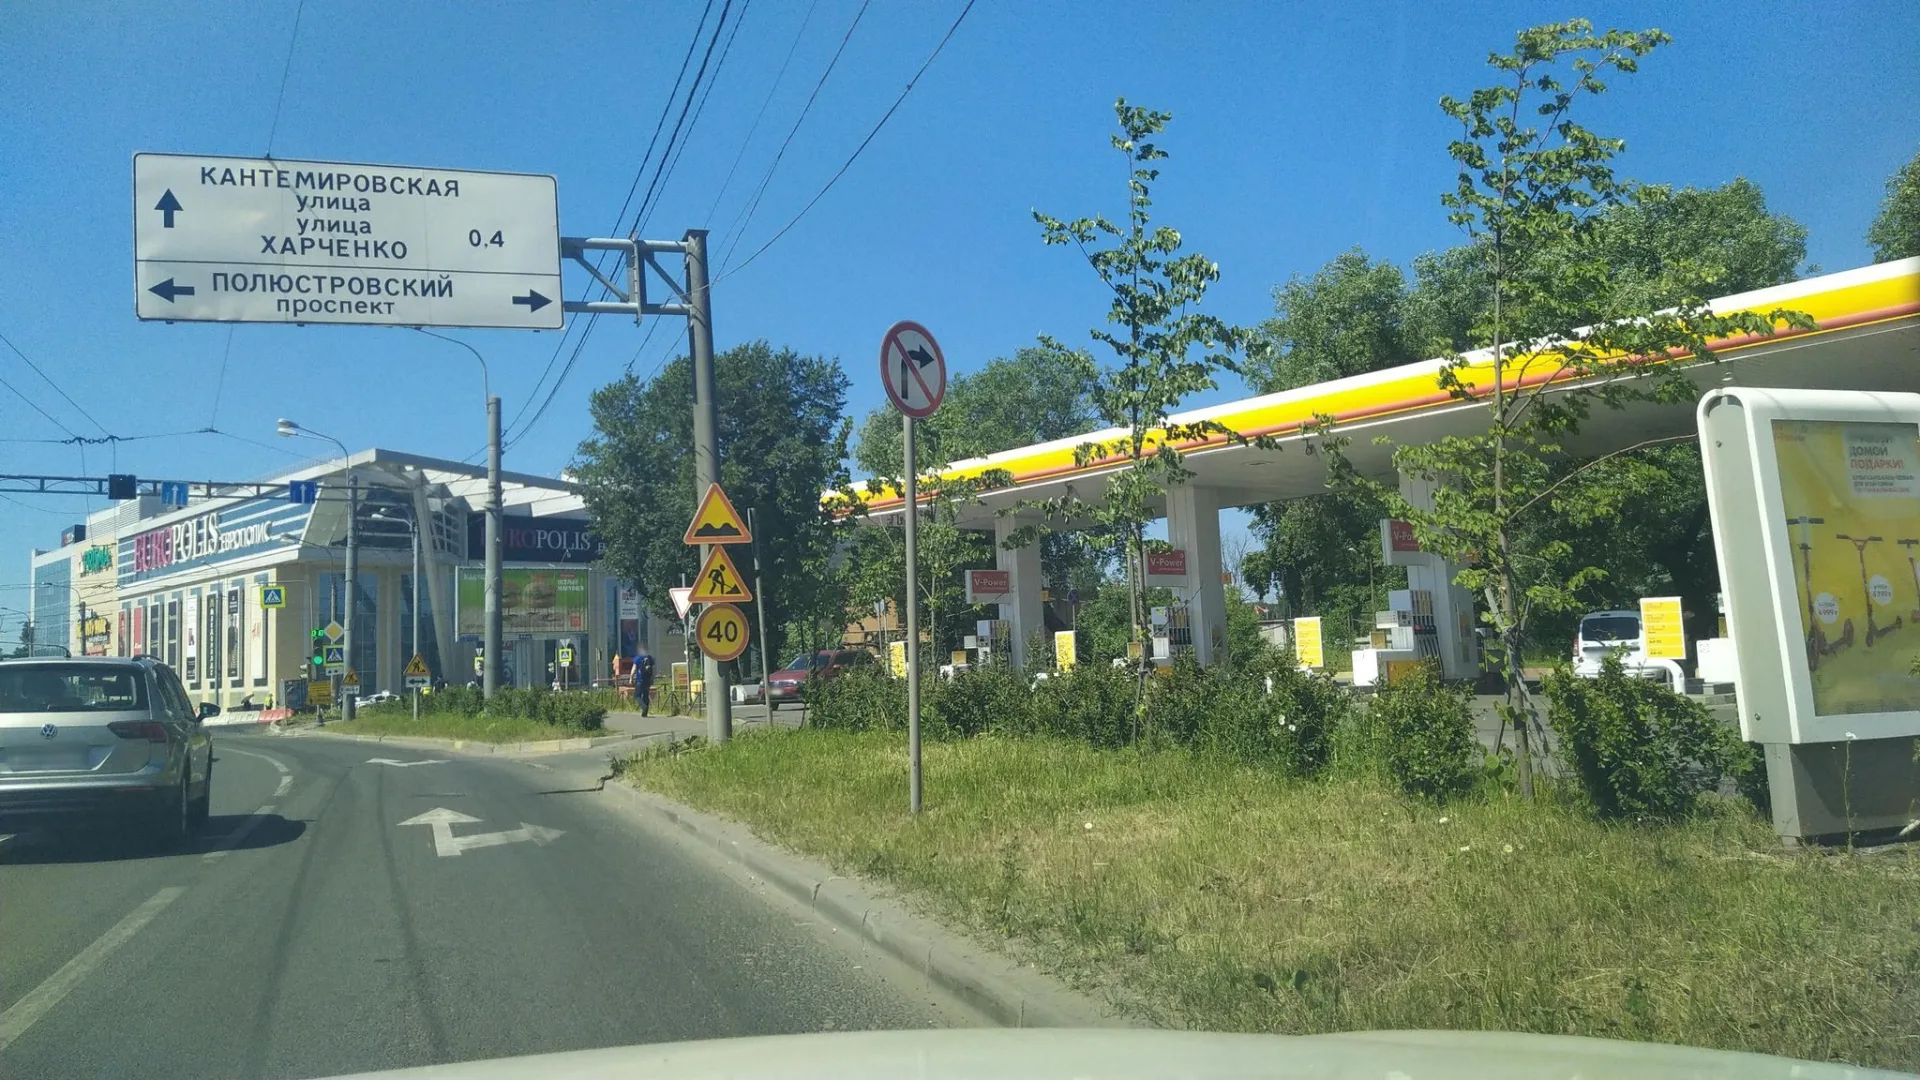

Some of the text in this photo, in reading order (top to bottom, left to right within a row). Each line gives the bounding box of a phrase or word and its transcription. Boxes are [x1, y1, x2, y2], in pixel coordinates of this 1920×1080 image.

[201, 166, 459, 198] КАНТЕМИРОВСКАЯ
[296, 194, 370, 213] улица
[296, 218, 371, 237] улица
[260, 235, 408, 260] ХАРЧЕНКО
[212, 272, 453, 298] ПОЛЮСТРОВСКИЙ
[277, 298, 395, 318] проспект
[133, 511, 220, 573] EUROPOLIS
[1150, 557, 1183, 567] V-Power
[973, 578, 1007, 586] V-Power
[707, 620, 738, 643] 40
